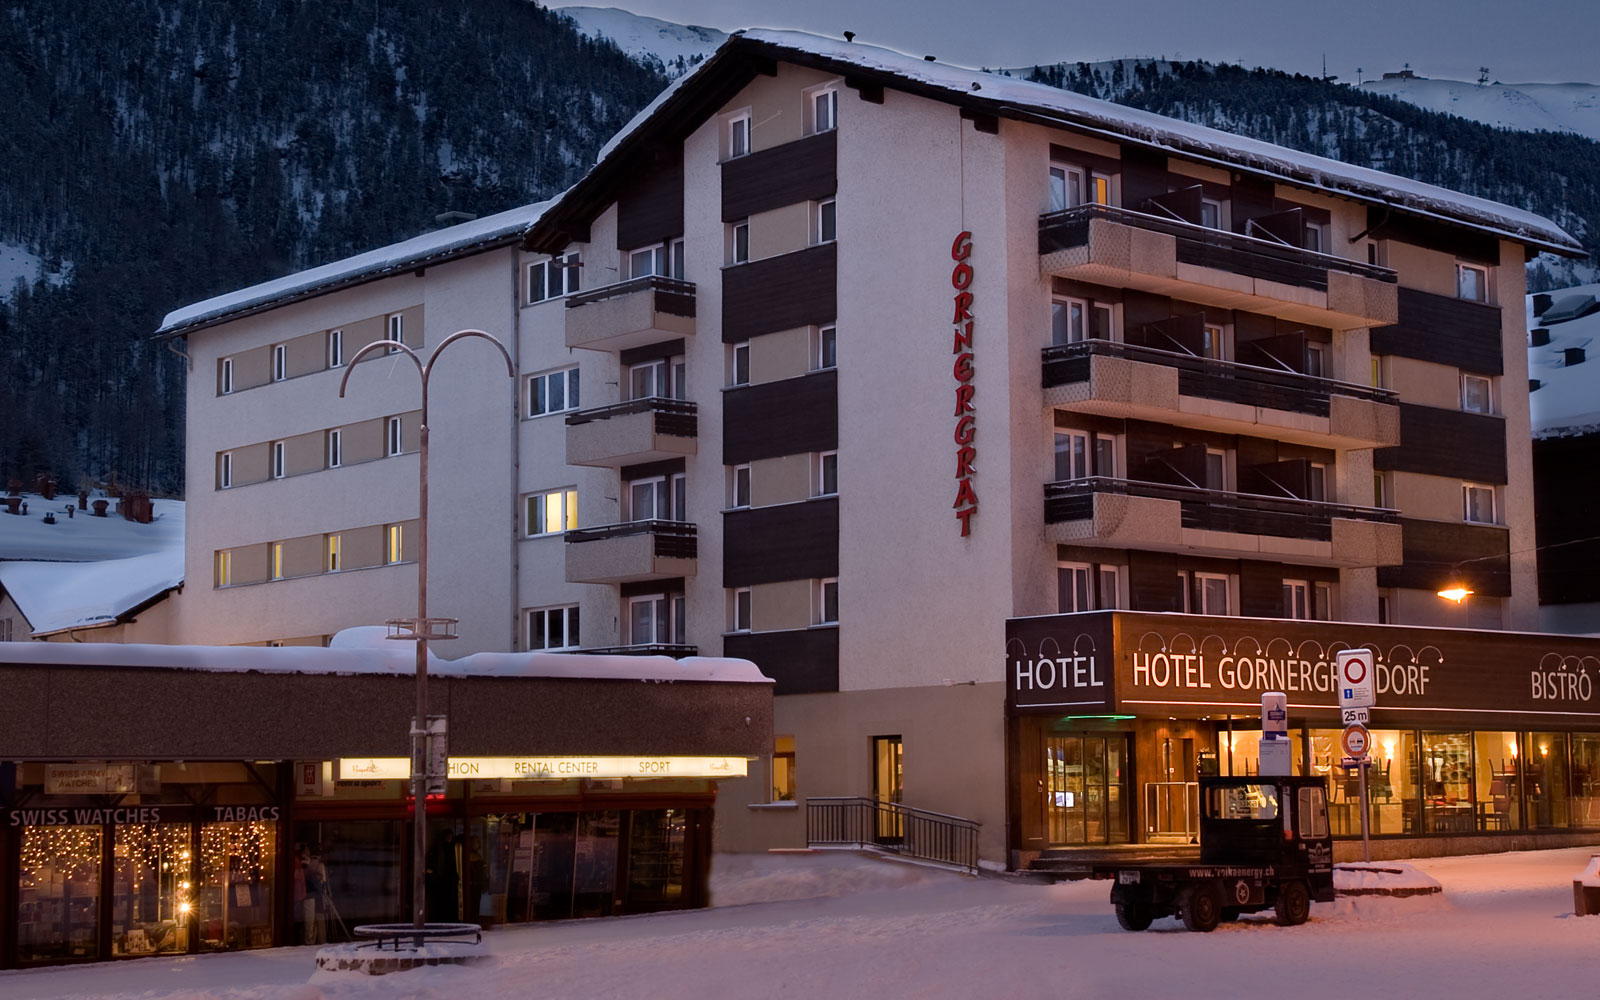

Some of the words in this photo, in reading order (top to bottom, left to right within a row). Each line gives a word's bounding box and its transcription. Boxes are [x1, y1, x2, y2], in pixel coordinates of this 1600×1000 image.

[951, 231, 979, 538] GORNERGRAT
[1016, 656, 1104, 690] HOTEL
[1133, 652, 1212, 688] HOTEL
[1218, 657, 1341, 693] GORNERGR
[1376, 664, 1430, 695] DORF
[1531, 670, 1592, 701] BISTRO
[1344, 710, 1356, 722] 25
[1357, 711, 1368, 722] m
[447, 762, 479, 774] HION
[514, 762, 554, 774] RENTAL
[558, 761, 598, 773] CENTER
[639, 761, 671, 773] SPORT
[10, 809, 69, 827] SWISS
[74, 807, 161, 825] WATCHES
[214, 806, 280, 822] TABACS
